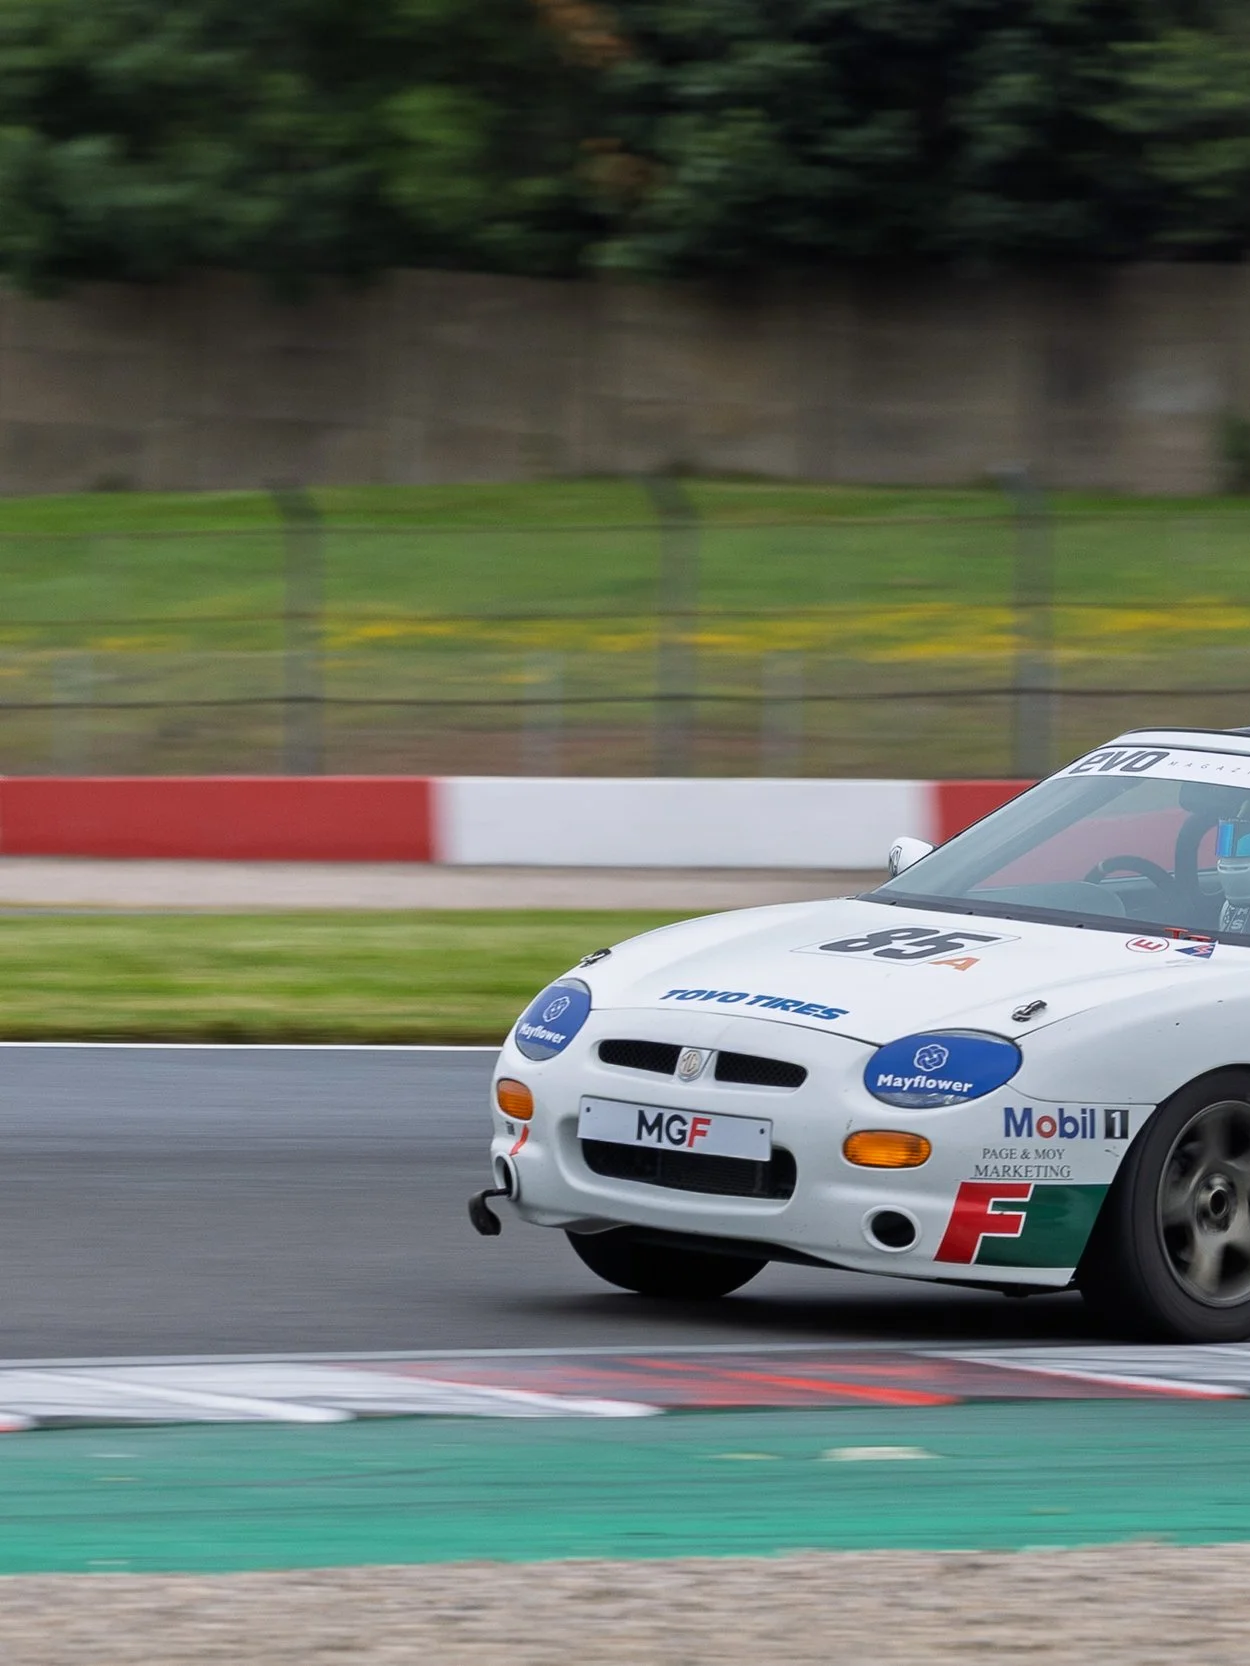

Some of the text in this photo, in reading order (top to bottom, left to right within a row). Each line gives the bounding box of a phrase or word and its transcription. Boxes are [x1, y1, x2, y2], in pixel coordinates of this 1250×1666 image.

[819, 927, 1002, 959] 85
[929, 956, 980, 971] A
[659, 989, 850, 1020] TOYO TIRES
[518, 1022, 567, 1044] Mayflower
[877, 1074, 973, 1093] Mayflower
[636, 1109, 712, 1147] MGF
[1004, 1107, 1096, 1139] Mobil
[982, 1148, 1065, 1160] PAGE & MOY
[974, 1164, 1072, 1178] MARKETING
[934, 1181, 1034, 1265] F
